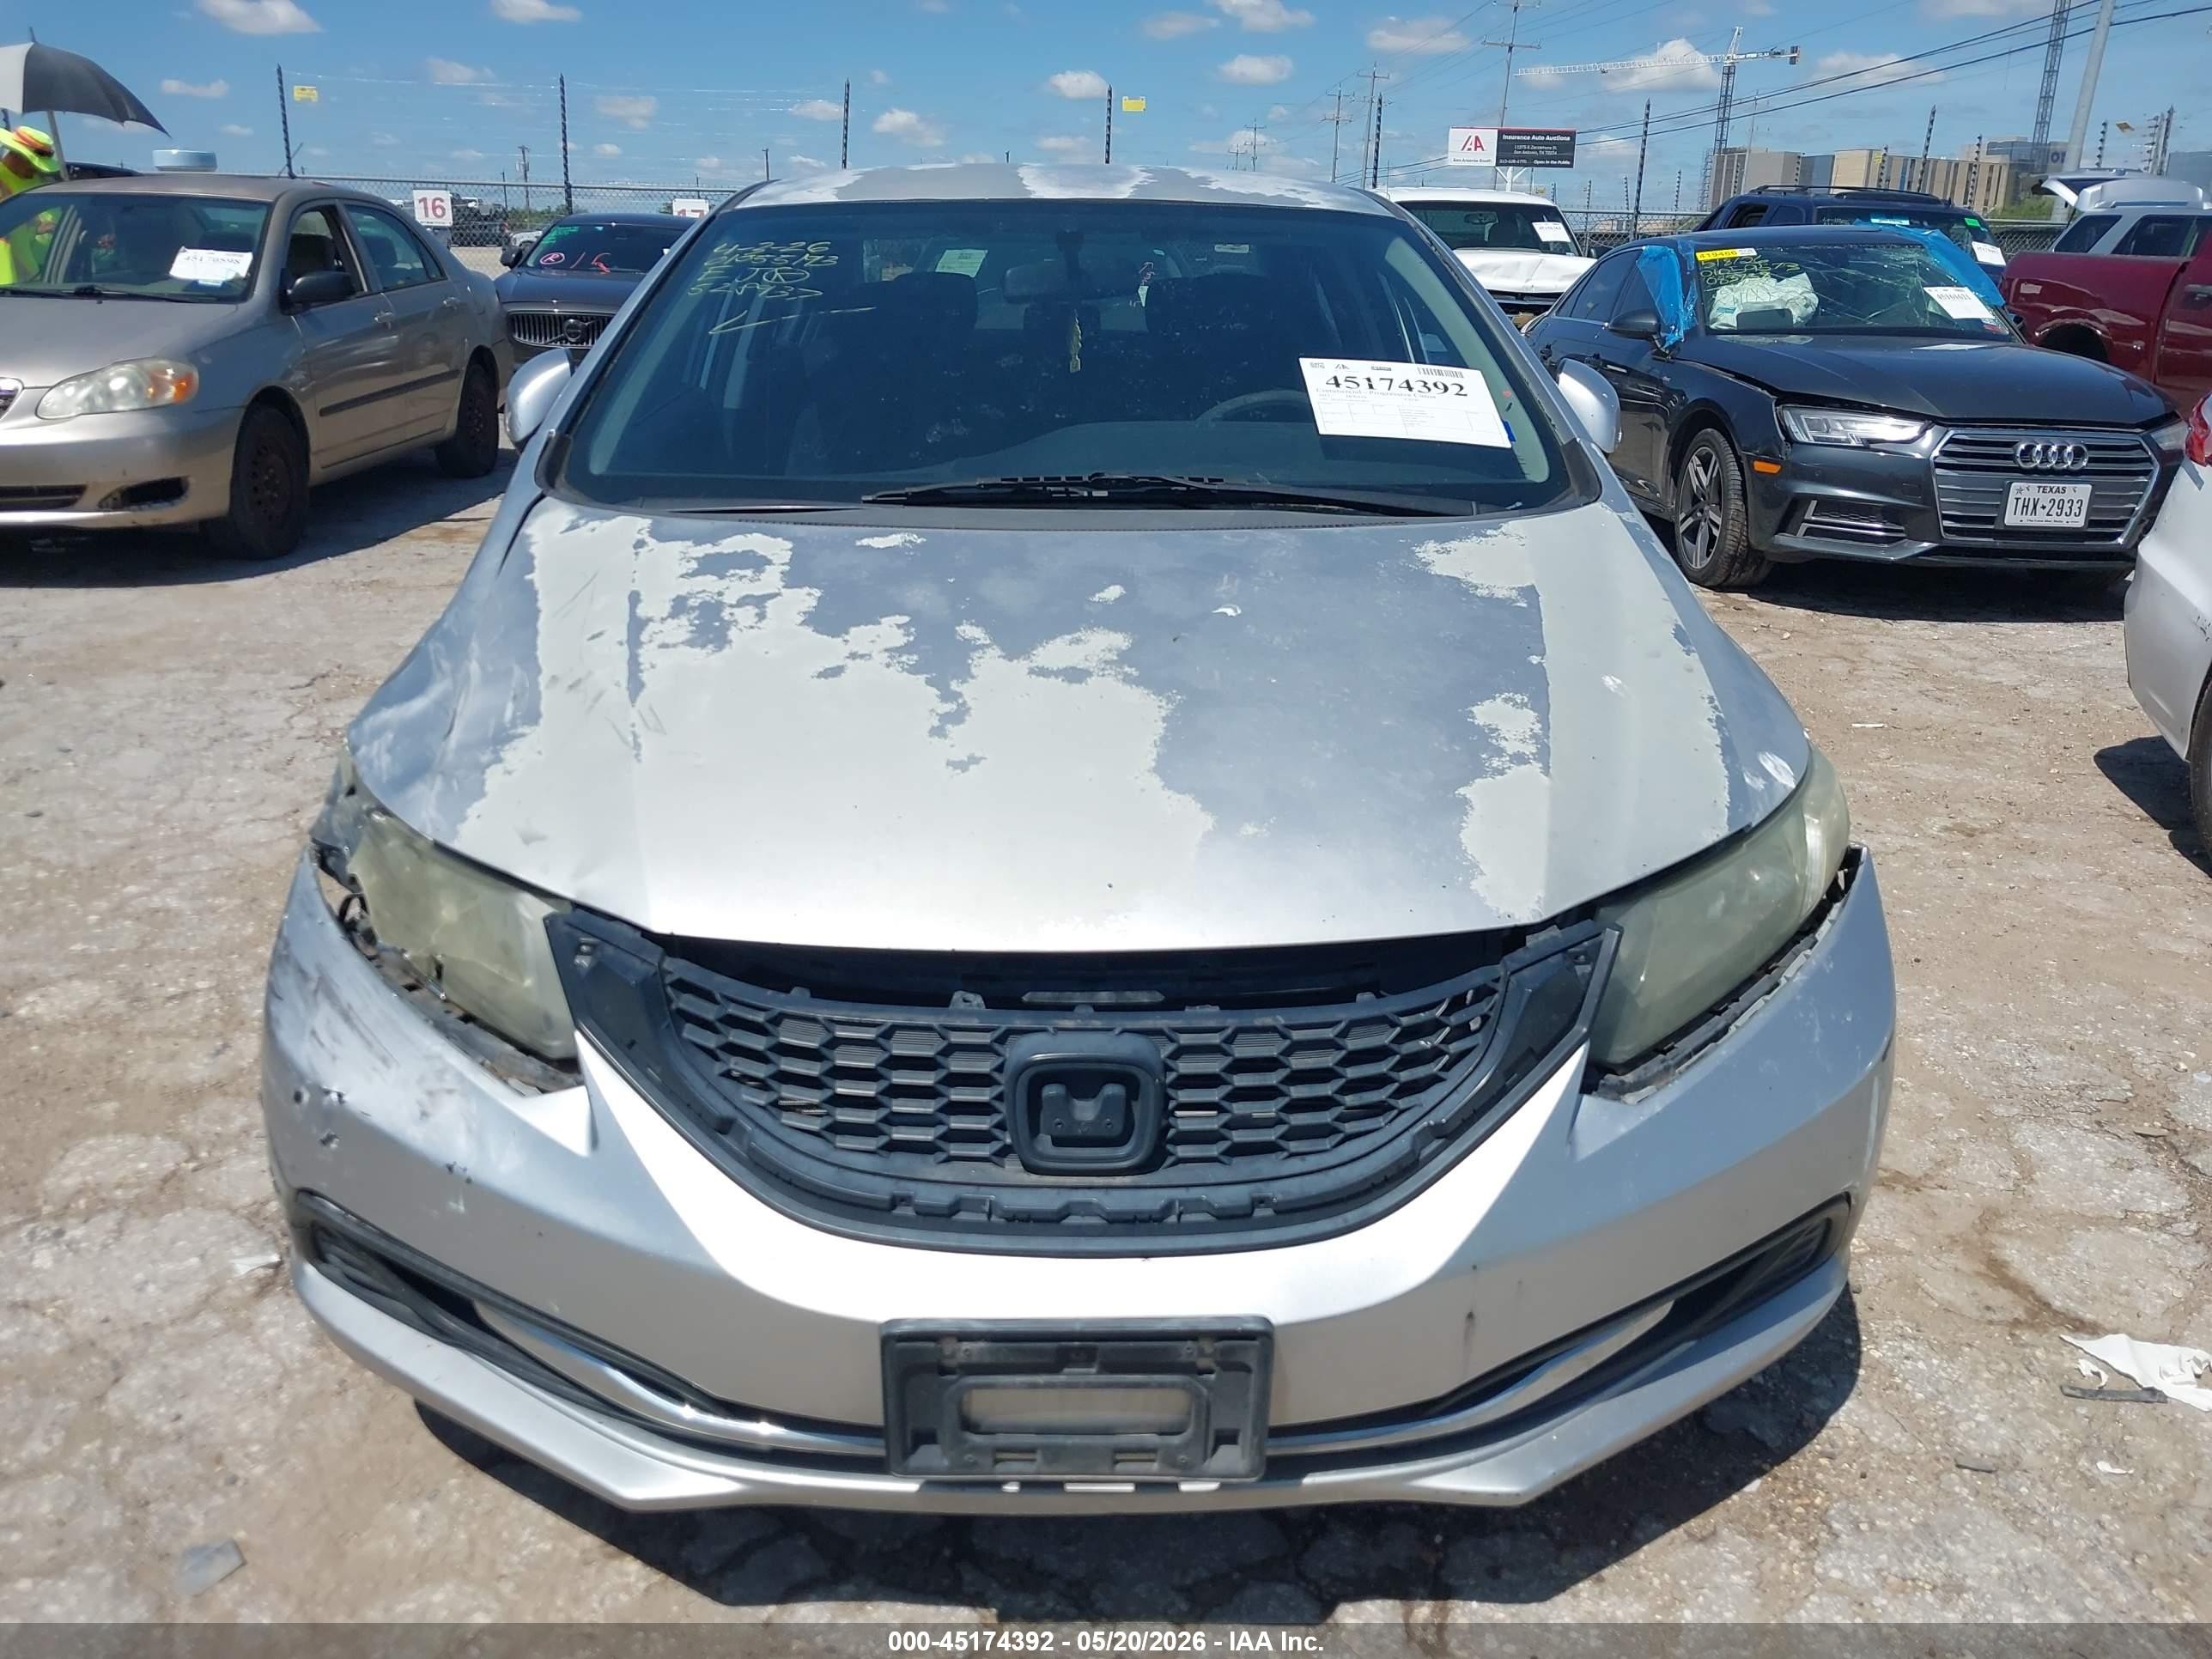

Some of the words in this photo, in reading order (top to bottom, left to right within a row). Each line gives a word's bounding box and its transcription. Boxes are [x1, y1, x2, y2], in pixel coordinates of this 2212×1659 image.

[418, 197, 447, 219] 16
[1325, 374, 1468, 397] 45174392
[2014, 497, 2039, 516] THX
[2045, 498, 2084, 517] 2933
